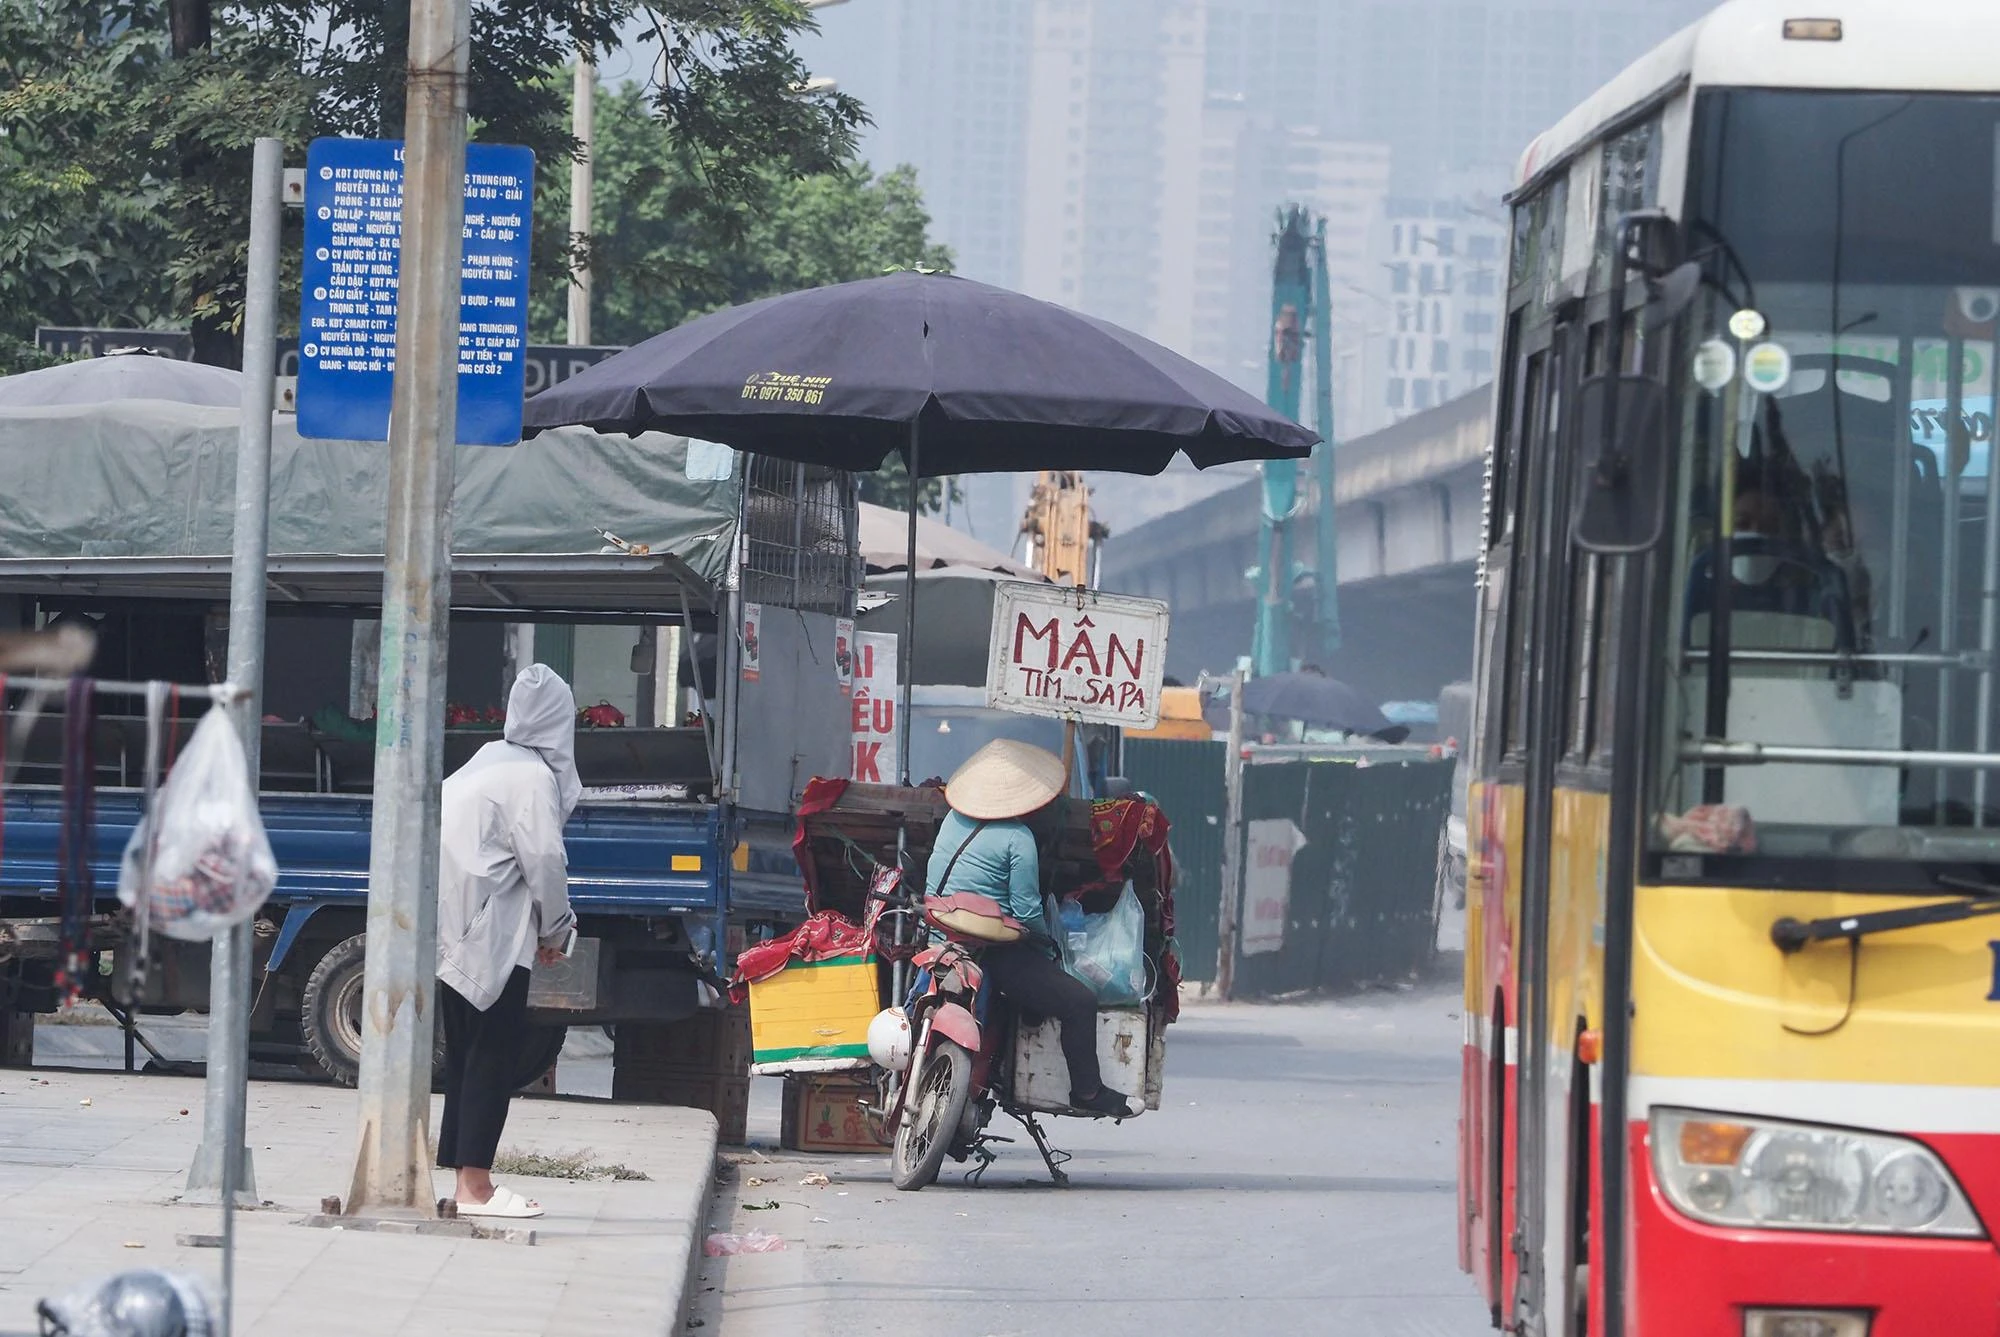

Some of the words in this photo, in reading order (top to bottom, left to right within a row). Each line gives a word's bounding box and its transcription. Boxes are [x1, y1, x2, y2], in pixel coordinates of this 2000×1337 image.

[370, 197, 381, 207] BX
[380, 238, 390, 247] BX
[345, 320, 369, 329] SMART
[371, 320, 387, 329] CITY
[476, 337, 485, 347] BX
[497, 365, 502, 374] 2
[759, 387, 783, 400] 0971
[784, 389, 804, 402] 350
[804, 390, 824, 405] 861
[1013, 611, 1144, 680] MẬN
